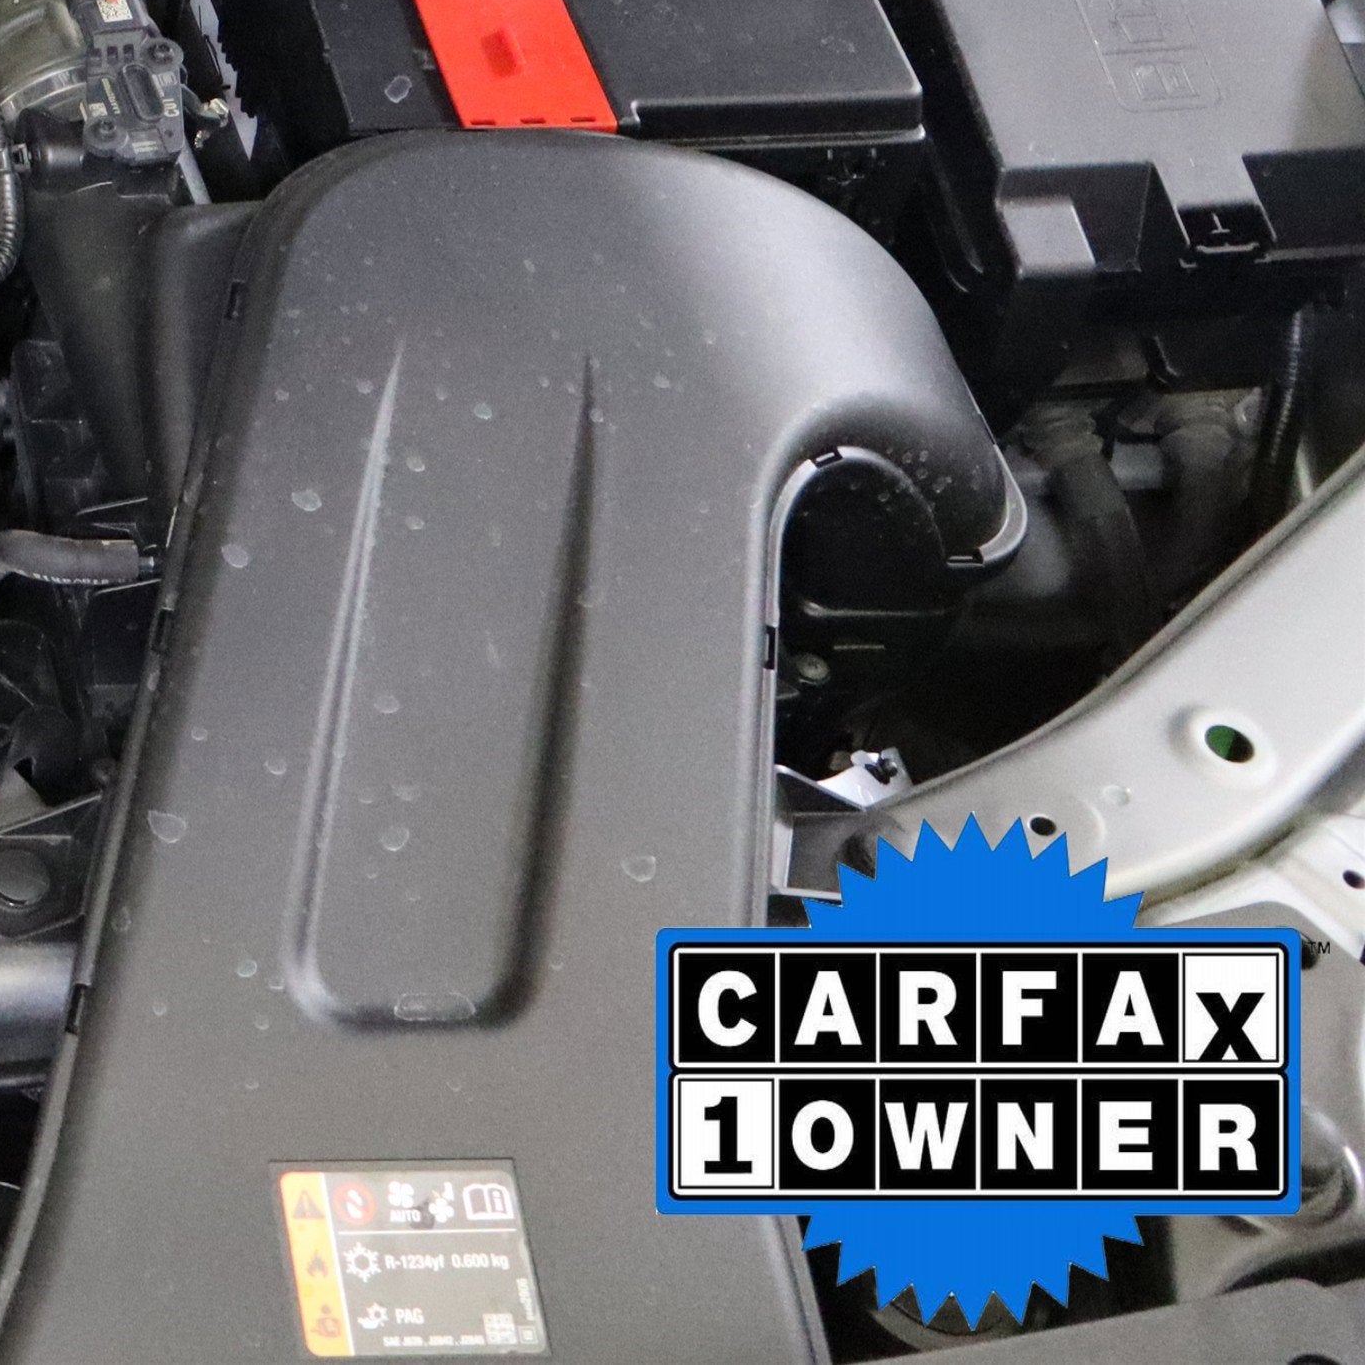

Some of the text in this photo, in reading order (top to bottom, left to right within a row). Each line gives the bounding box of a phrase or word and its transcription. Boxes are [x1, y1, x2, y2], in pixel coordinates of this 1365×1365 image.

[389, 1209, 421, 1223] AUTO
[385, 1254, 445, 1273] R-1234yf
[491, 1253, 510, 1271] kg
[395, 1308, 424, 1324] PAG
